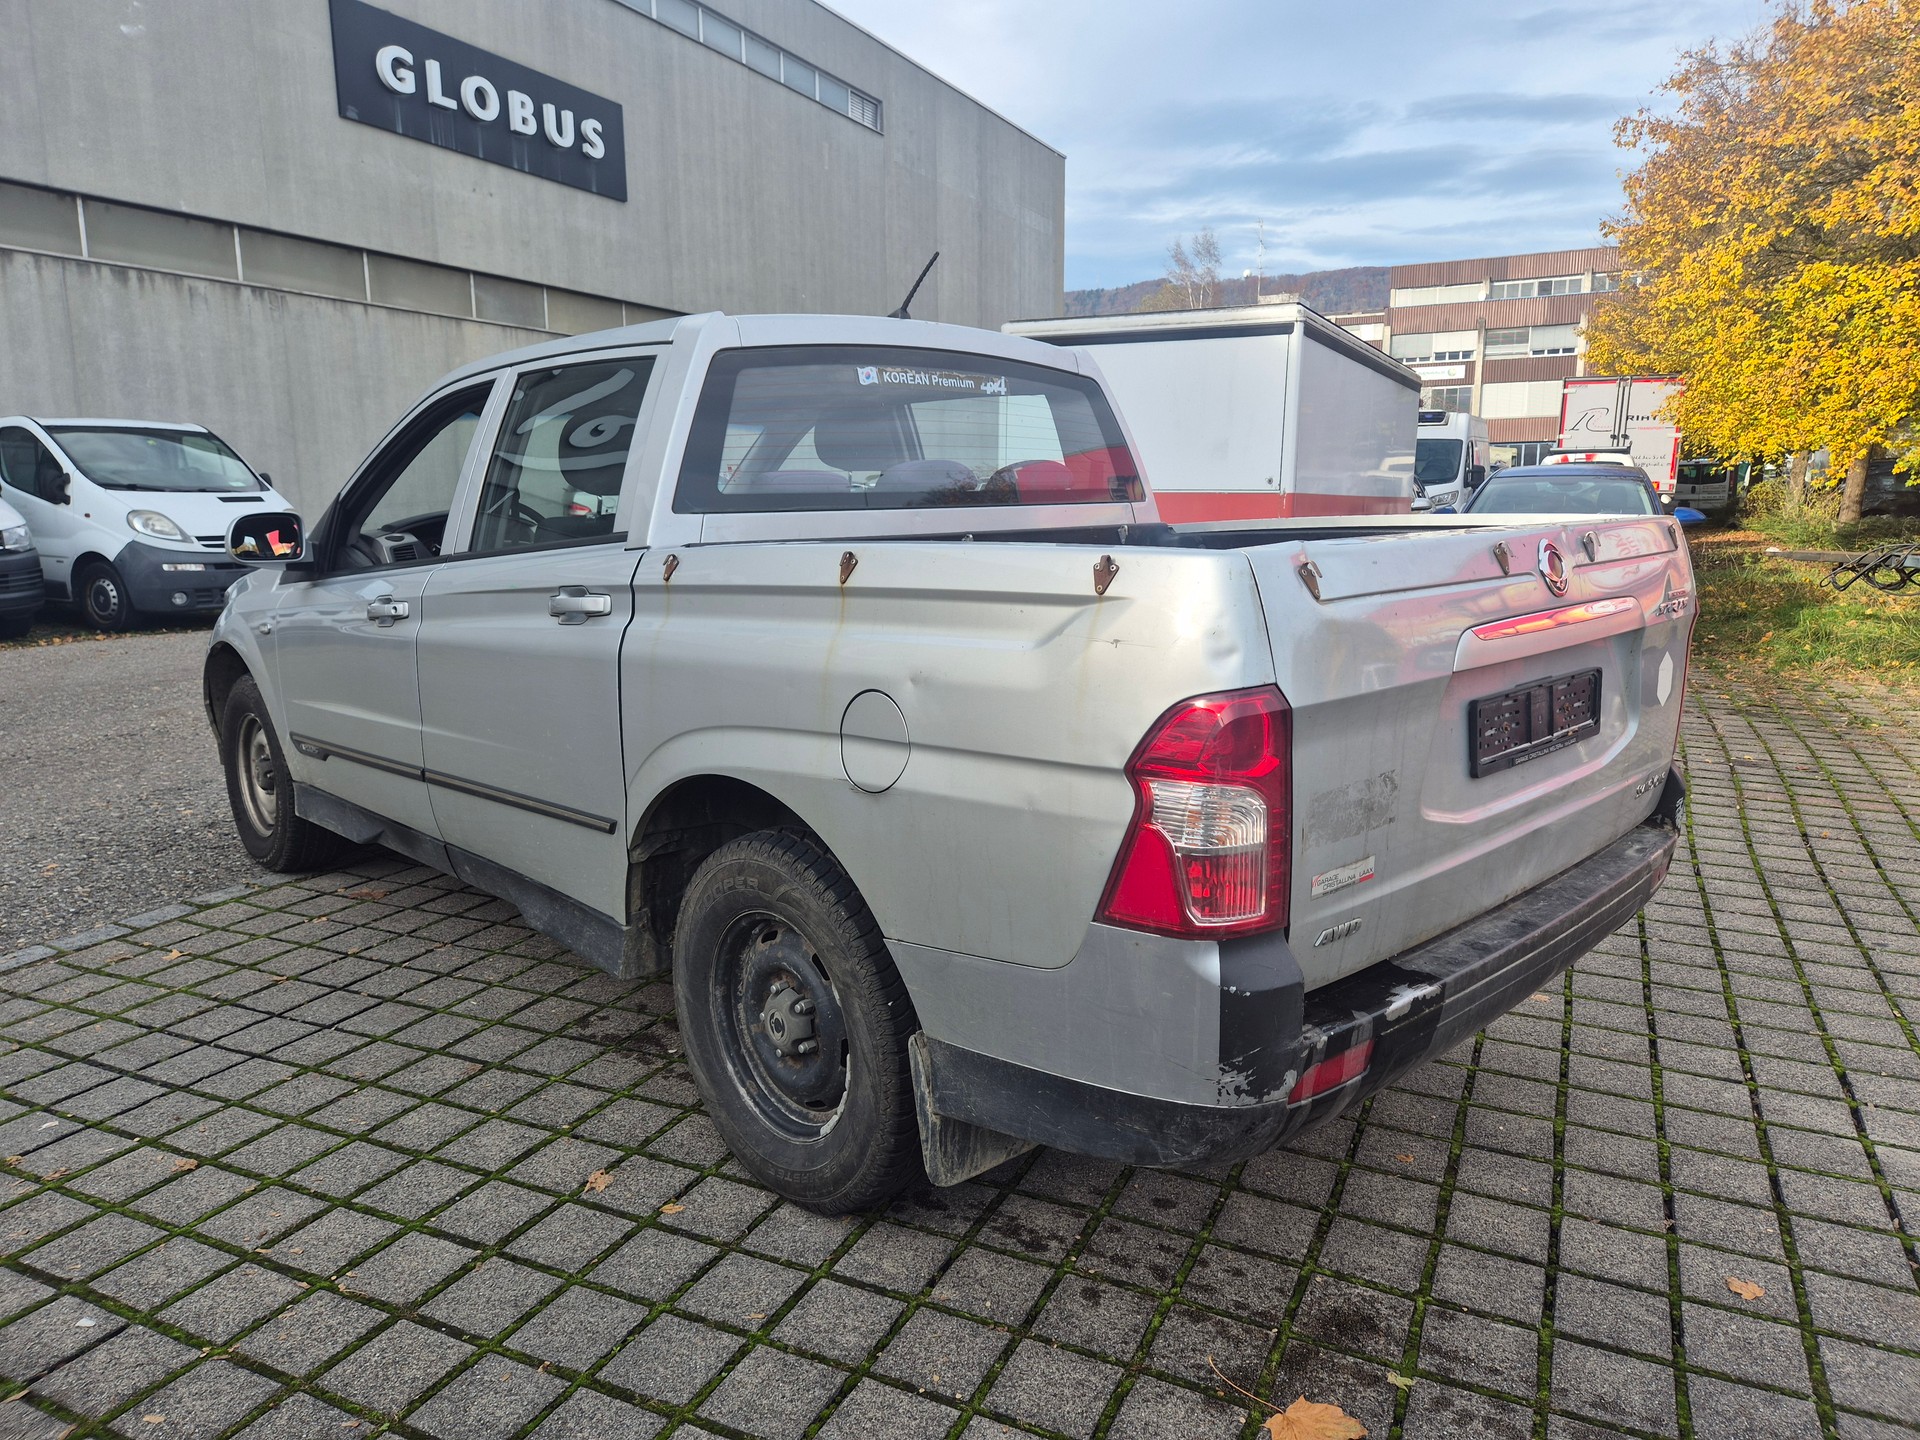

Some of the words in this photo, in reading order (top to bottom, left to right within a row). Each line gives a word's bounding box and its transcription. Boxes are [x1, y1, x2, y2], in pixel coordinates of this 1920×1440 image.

[375, 44, 606, 159] GLOBUS
[882, 371, 930, 386] KOREAN
[932, 374, 975, 389] Premium
[1317, 873, 1340, 887] GARAGE
[1322, 873, 1356, 891] CRISTALLINA
[1359, 867, 1374, 878] LAAX
[1313, 917, 1363, 947] AWD
